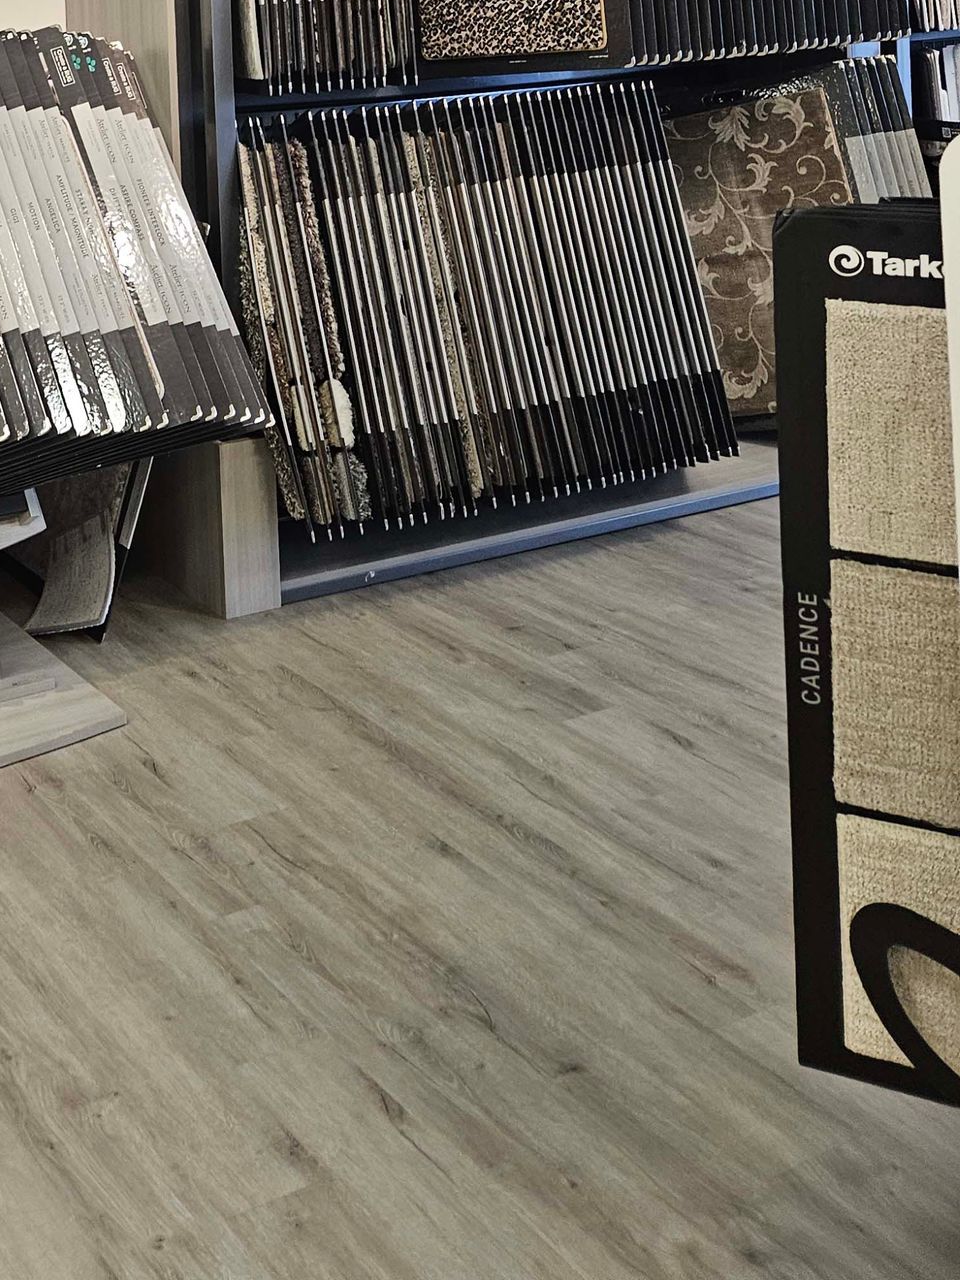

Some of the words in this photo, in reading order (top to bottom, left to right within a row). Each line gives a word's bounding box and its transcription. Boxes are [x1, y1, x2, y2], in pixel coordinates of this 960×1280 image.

[57, 50, 66, 66] Create
[64, 70, 72, 82] RUG
[103, 61, 112, 76] Create
[118, 66, 126, 82] Create
[96, 116, 110, 140] Atelier
[105, 142, 116, 163] ICON
[114, 118, 128, 141] Atelier
[123, 143, 135, 164] ICON
[9, 207, 19, 223] GIGI
[26, 201, 40, 231] MOTION
[44, 197, 61, 233] ANGELICA
[55, 173, 73, 212] AMPLITUDE
[70, 216, 89, 258] MAGNITUDE
[74, 188, 88, 215] STARRY
[119, 183, 132, 207] ASPIRE
[128, 207, 144, 241] COMPASS
[136, 178, 151, 207] PIONEER
[147, 207, 166, 246] INTERLOCK
[866, 251, 944, 278] Tark
[91, 273, 103, 295] Atelier
[149, 262, 164, 288] Atelier
[159, 290, 172, 313] ICON
[168, 262, 184, 288] Atelier
[179, 290, 191, 313] ICON
[798, 592, 821, 705] CADENCE
